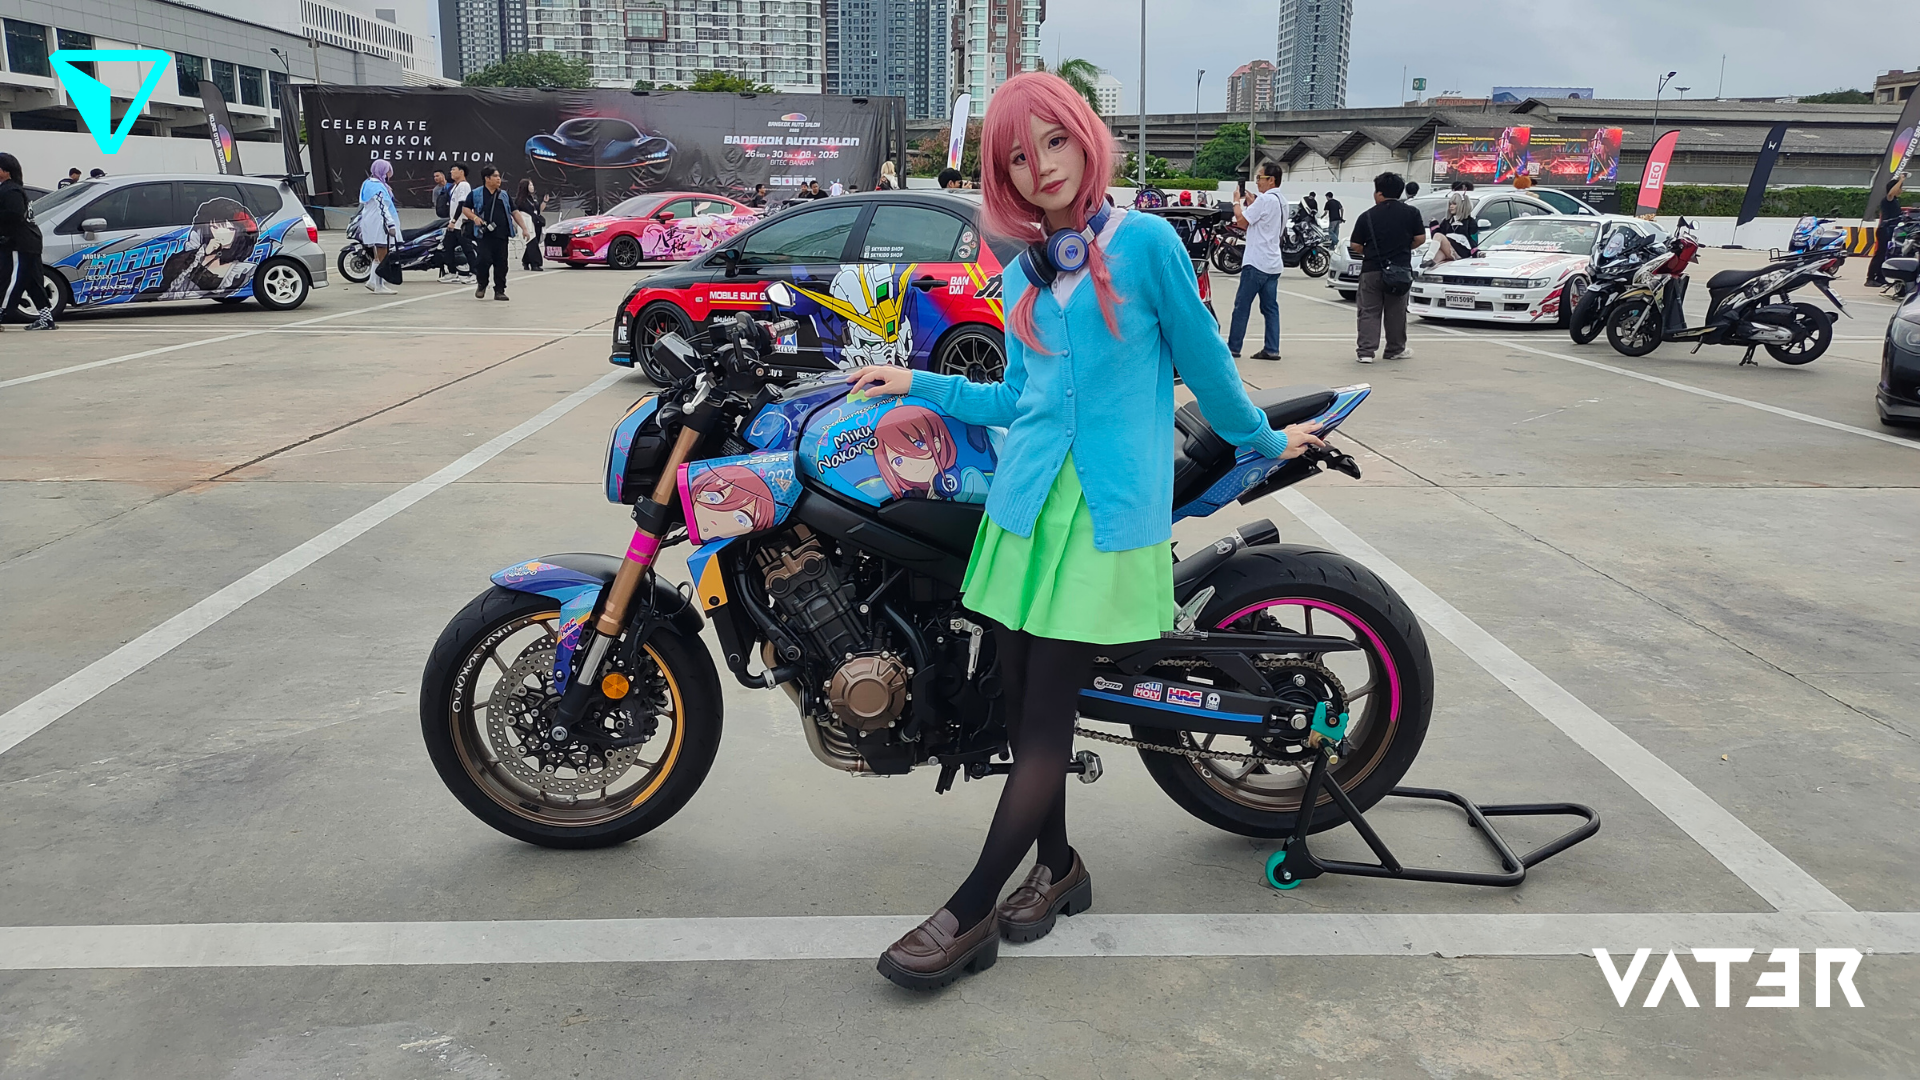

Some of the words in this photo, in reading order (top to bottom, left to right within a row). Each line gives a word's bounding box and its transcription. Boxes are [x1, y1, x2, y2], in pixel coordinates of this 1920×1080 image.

[321, 119, 427, 131] CELEBRATE
[345, 135, 432, 146] BANGKOK
[723, 136, 783, 145] BANGKOK
[785, 137, 818, 145] AUTO
[820, 137, 860, 146] SALON
[370, 150, 494, 162] DESTINATION
[745, 150, 756, 158] 26
[772, 150, 783, 158] 30
[818, 151, 839, 159] 2026
[1649, 165, 1661, 186] LEO
[950, 276, 969, 285] BAN
[709, 291, 738, 299] MOBILE
[740, 291, 758, 300] SUIT
[949, 285, 964, 295] DAI
[833, 425, 873, 449] Miku
[817, 436, 879, 474] Nakano
[560, 618, 578, 635] HRC
[1135, 688, 1160, 700] MOLY
[1168, 689, 1202, 702] HRC
